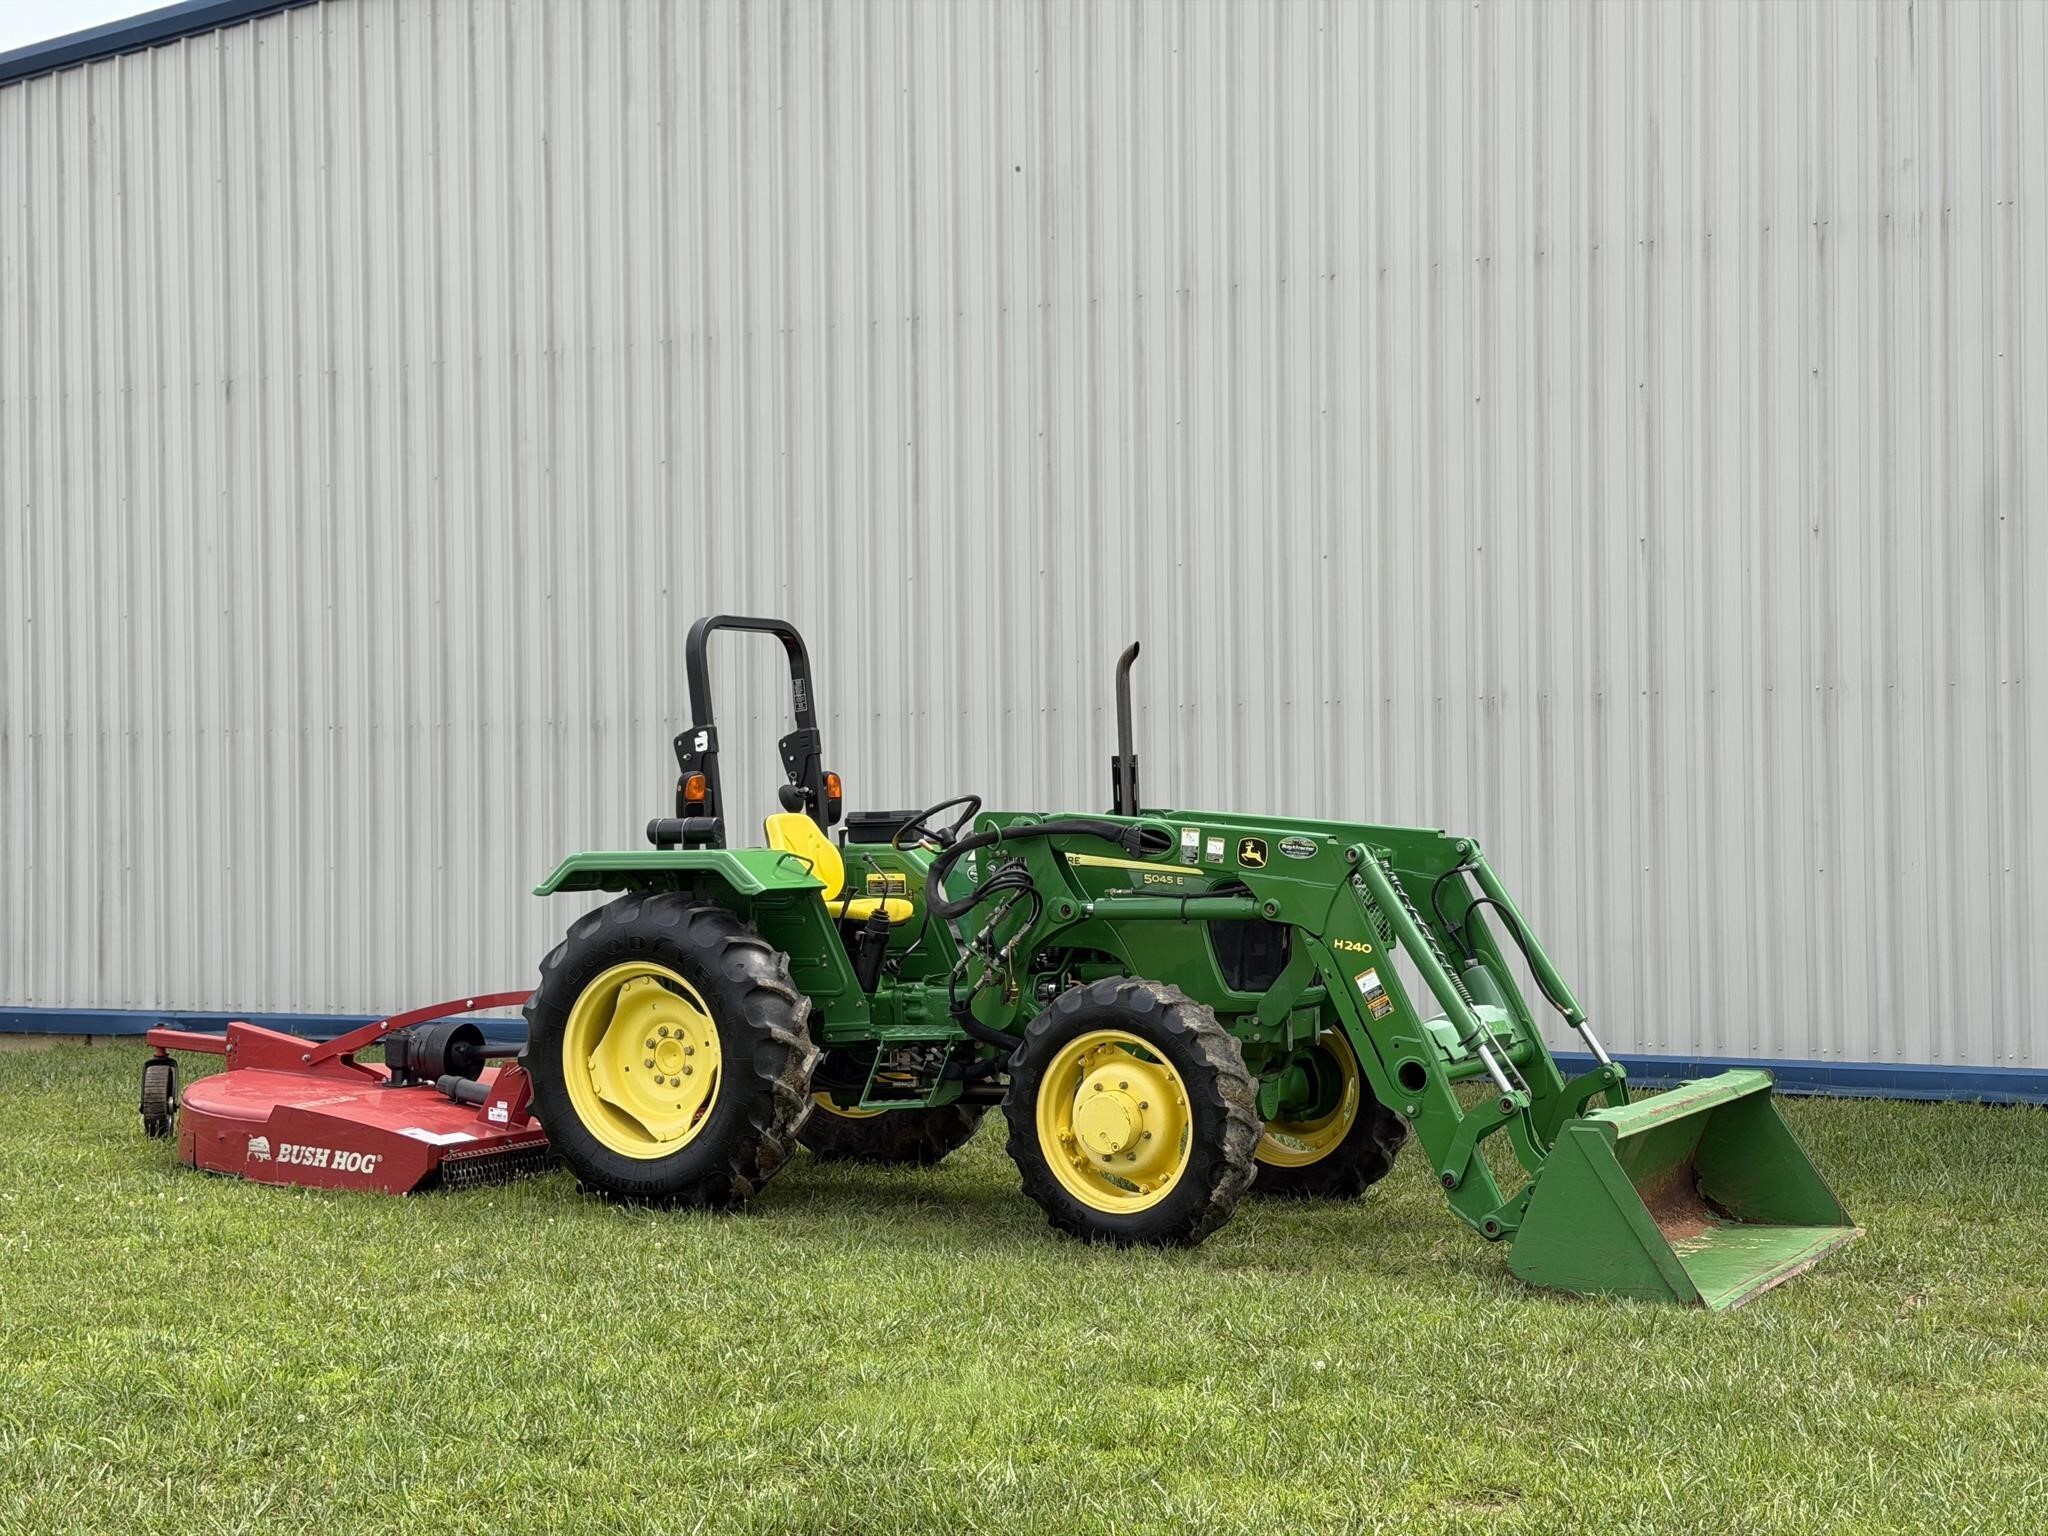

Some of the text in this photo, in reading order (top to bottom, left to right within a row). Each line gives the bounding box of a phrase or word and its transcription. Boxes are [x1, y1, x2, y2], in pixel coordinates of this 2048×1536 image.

[1143, 873, 1184, 885] 5045 E
[1334, 939, 1372, 953] H240
[277, 1143, 377, 1174] BUSH HOG
